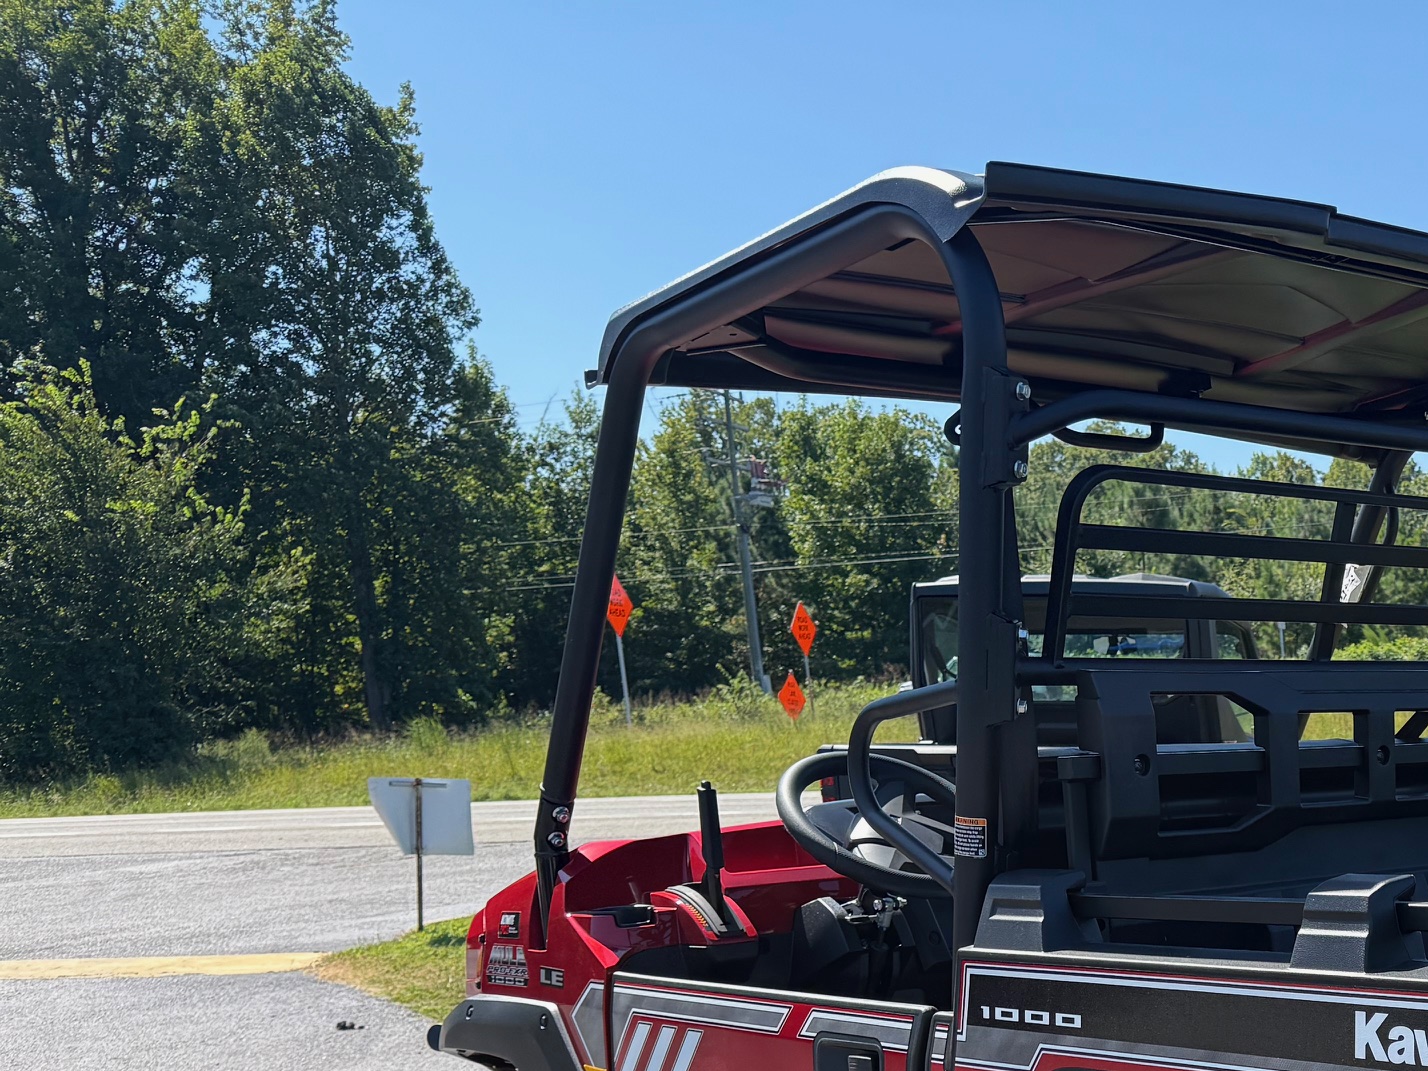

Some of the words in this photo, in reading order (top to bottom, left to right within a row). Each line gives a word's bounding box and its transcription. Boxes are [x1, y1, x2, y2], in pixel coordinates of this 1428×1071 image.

[489, 945, 527, 966] MULE
[491, 976, 525, 986] 1000
[540, 969, 563, 987] LE
[980, 1005, 1082, 1028] 1000
